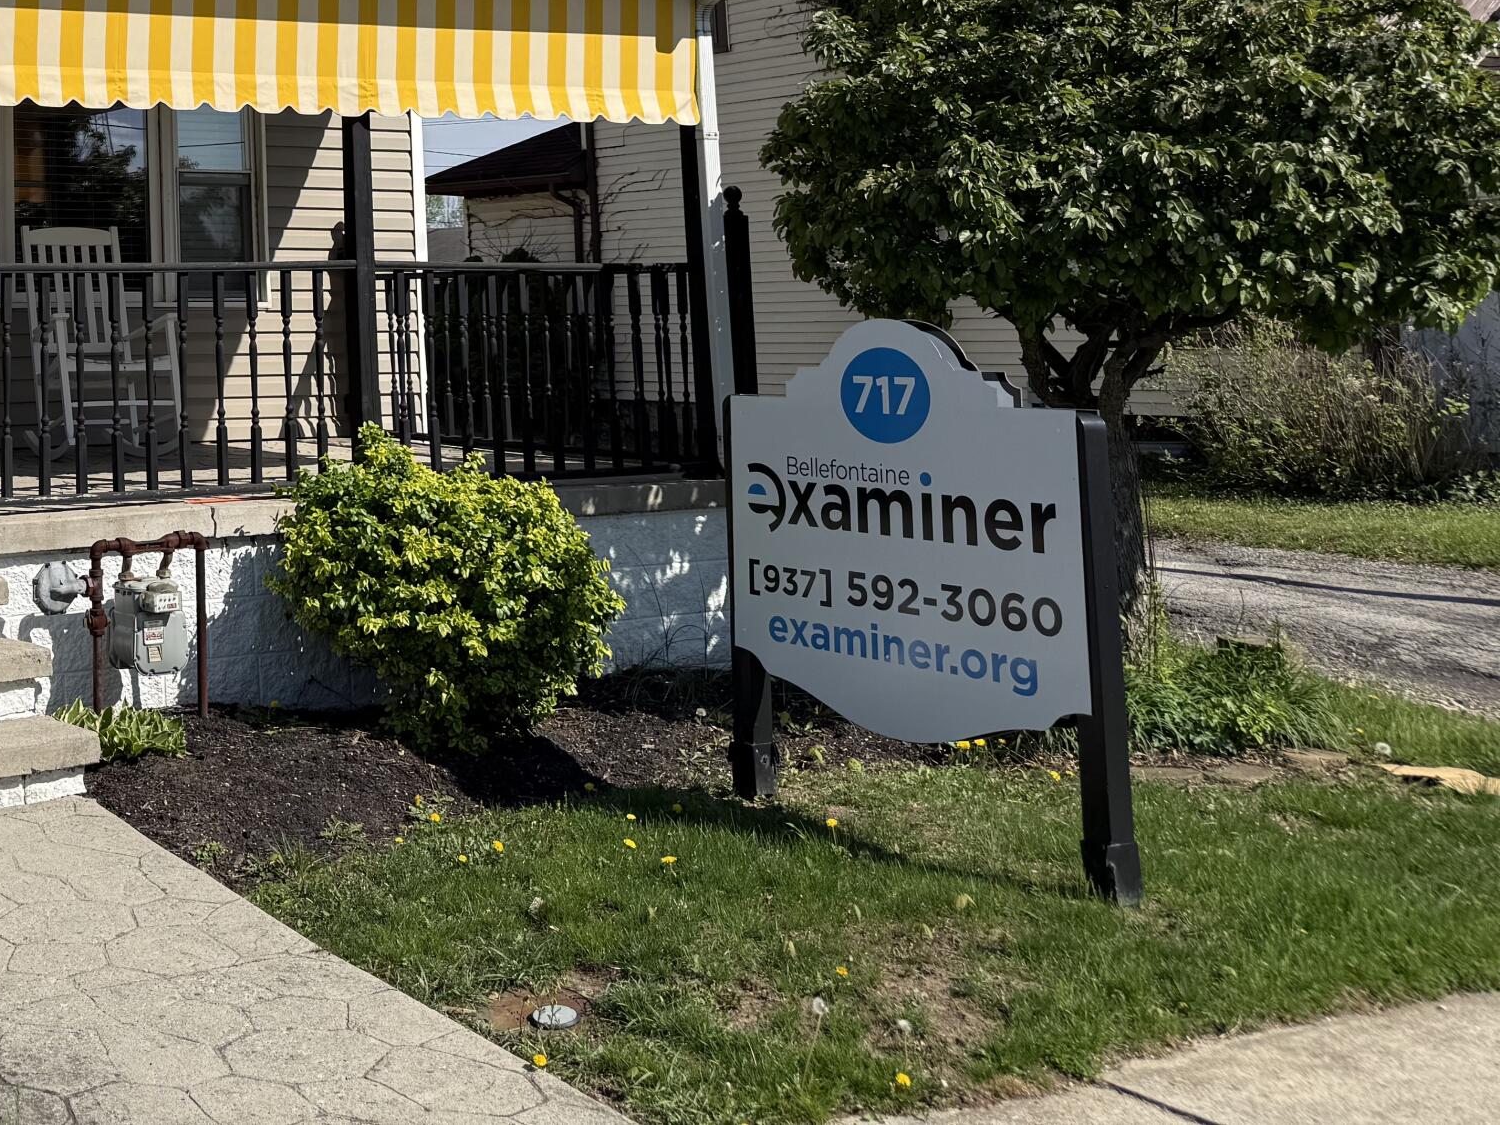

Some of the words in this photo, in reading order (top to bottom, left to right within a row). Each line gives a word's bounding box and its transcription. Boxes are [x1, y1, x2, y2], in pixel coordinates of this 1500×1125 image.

[851, 375, 916, 416] 717
[747, 462, 1057, 554] examiner
[786, 456, 910, 486] Bellefontaine
[749, 558, 833, 608] [937]
[847, 571, 1064, 638] 592-3060
[768, 615, 1039, 697] examiner.org
